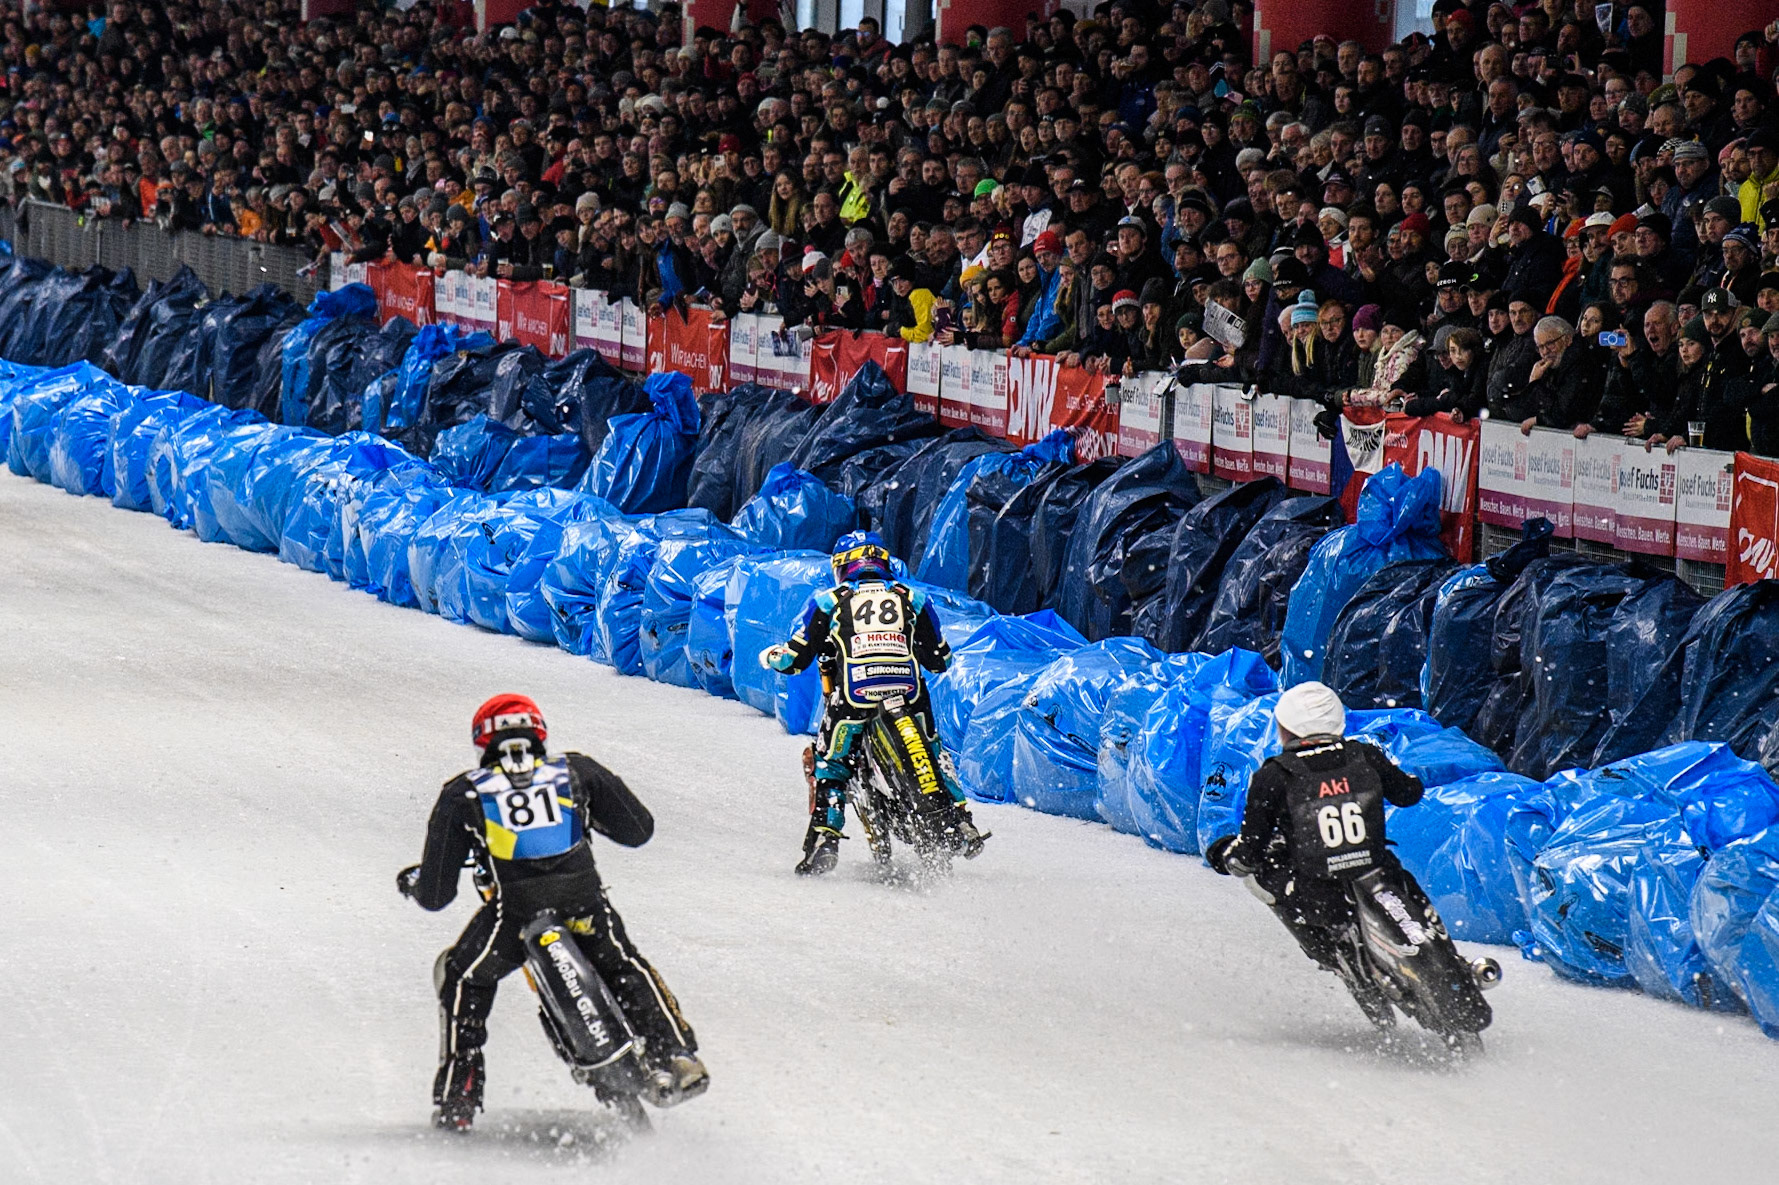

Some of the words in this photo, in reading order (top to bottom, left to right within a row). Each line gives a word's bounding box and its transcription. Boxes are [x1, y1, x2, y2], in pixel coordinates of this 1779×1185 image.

[1122, 386, 1136, 404] Josef
[1544, 453, 1560, 474] Fuchs
[1619, 467, 1635, 490] Josef
[1635, 469, 1659, 490] Fuchs
[1679, 473, 1697, 498] Josef
[1697, 475, 1716, 498] Fuchs
[1616, 524, 1638, 540] Menschen.
[1639, 526, 1654, 542] Bauen.
[1655, 529, 1670, 544] Werte.
[1698, 534, 1712, 550] Bauen.
[1712, 537, 1726, 552] Werte.
[854, 600, 899, 625] 48
[866, 666, 910, 676] Silkolene
[1319, 777, 1350, 798] Aki
[505, 787, 556, 827] 81
[1318, 802, 1366, 848] 66
